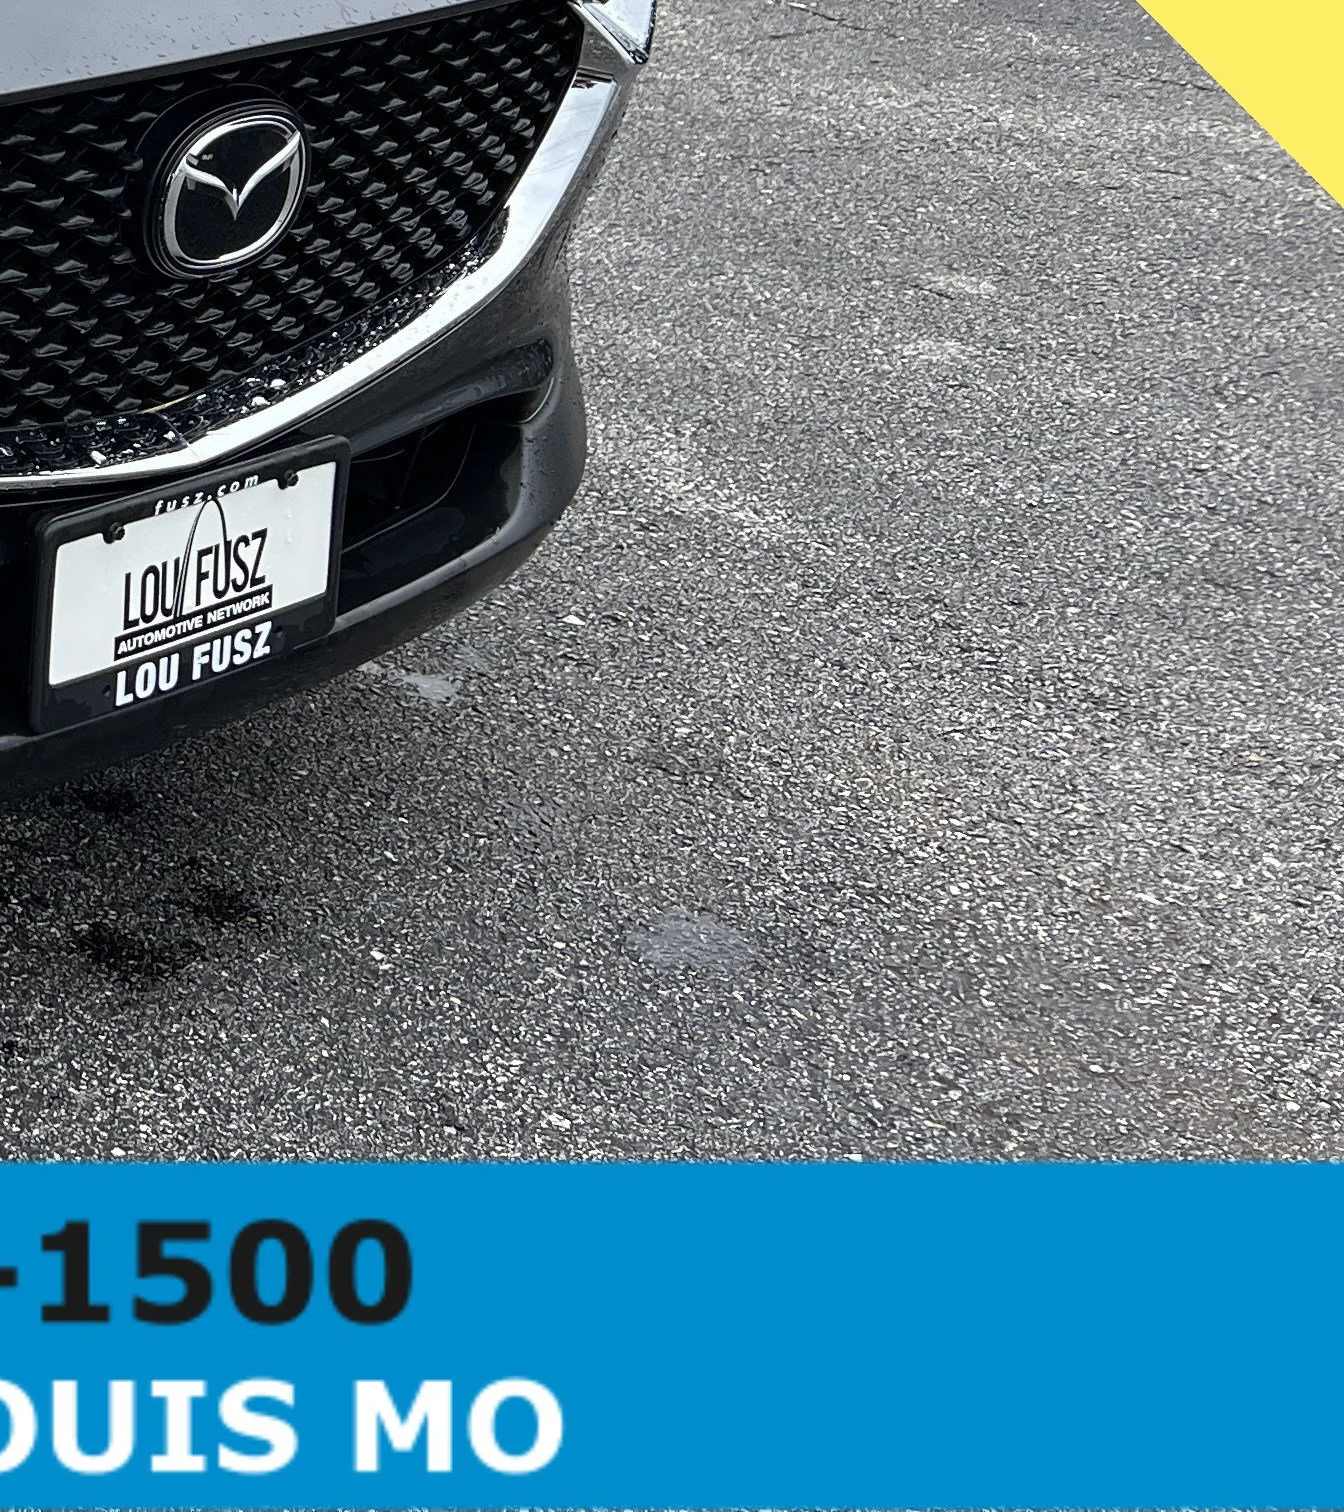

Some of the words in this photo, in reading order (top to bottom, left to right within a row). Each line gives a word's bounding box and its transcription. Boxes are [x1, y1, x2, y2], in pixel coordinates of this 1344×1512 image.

[154, 473, 260, 516] fusz.com
[123, 556, 181, 631] LOU
[195, 527, 269, 607] FUSZ
[117, 614, 203, 655] AUTOMOTIVE
[206, 591, 270, 625] NETWORK
[115, 652, 180, 707] LOU
[191, 620, 273, 681] FUSZ
